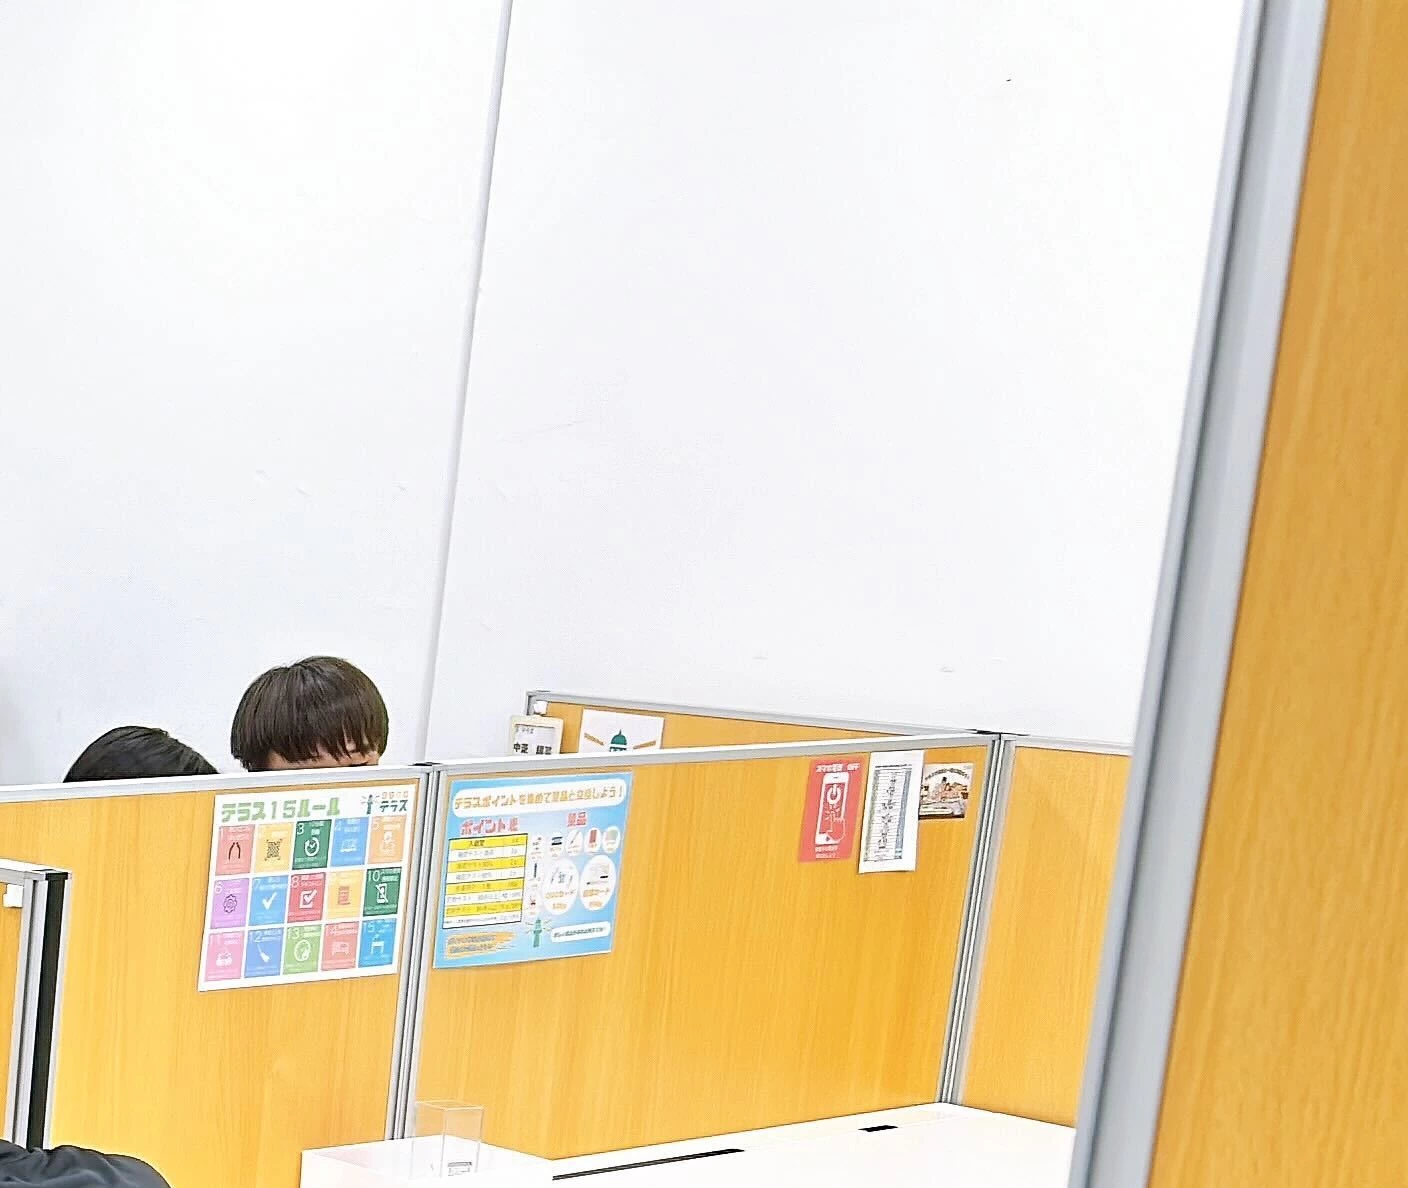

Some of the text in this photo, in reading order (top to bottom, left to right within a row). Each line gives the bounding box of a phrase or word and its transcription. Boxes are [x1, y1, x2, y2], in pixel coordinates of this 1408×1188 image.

[222, 797, 340, 823] テラス15ルール
